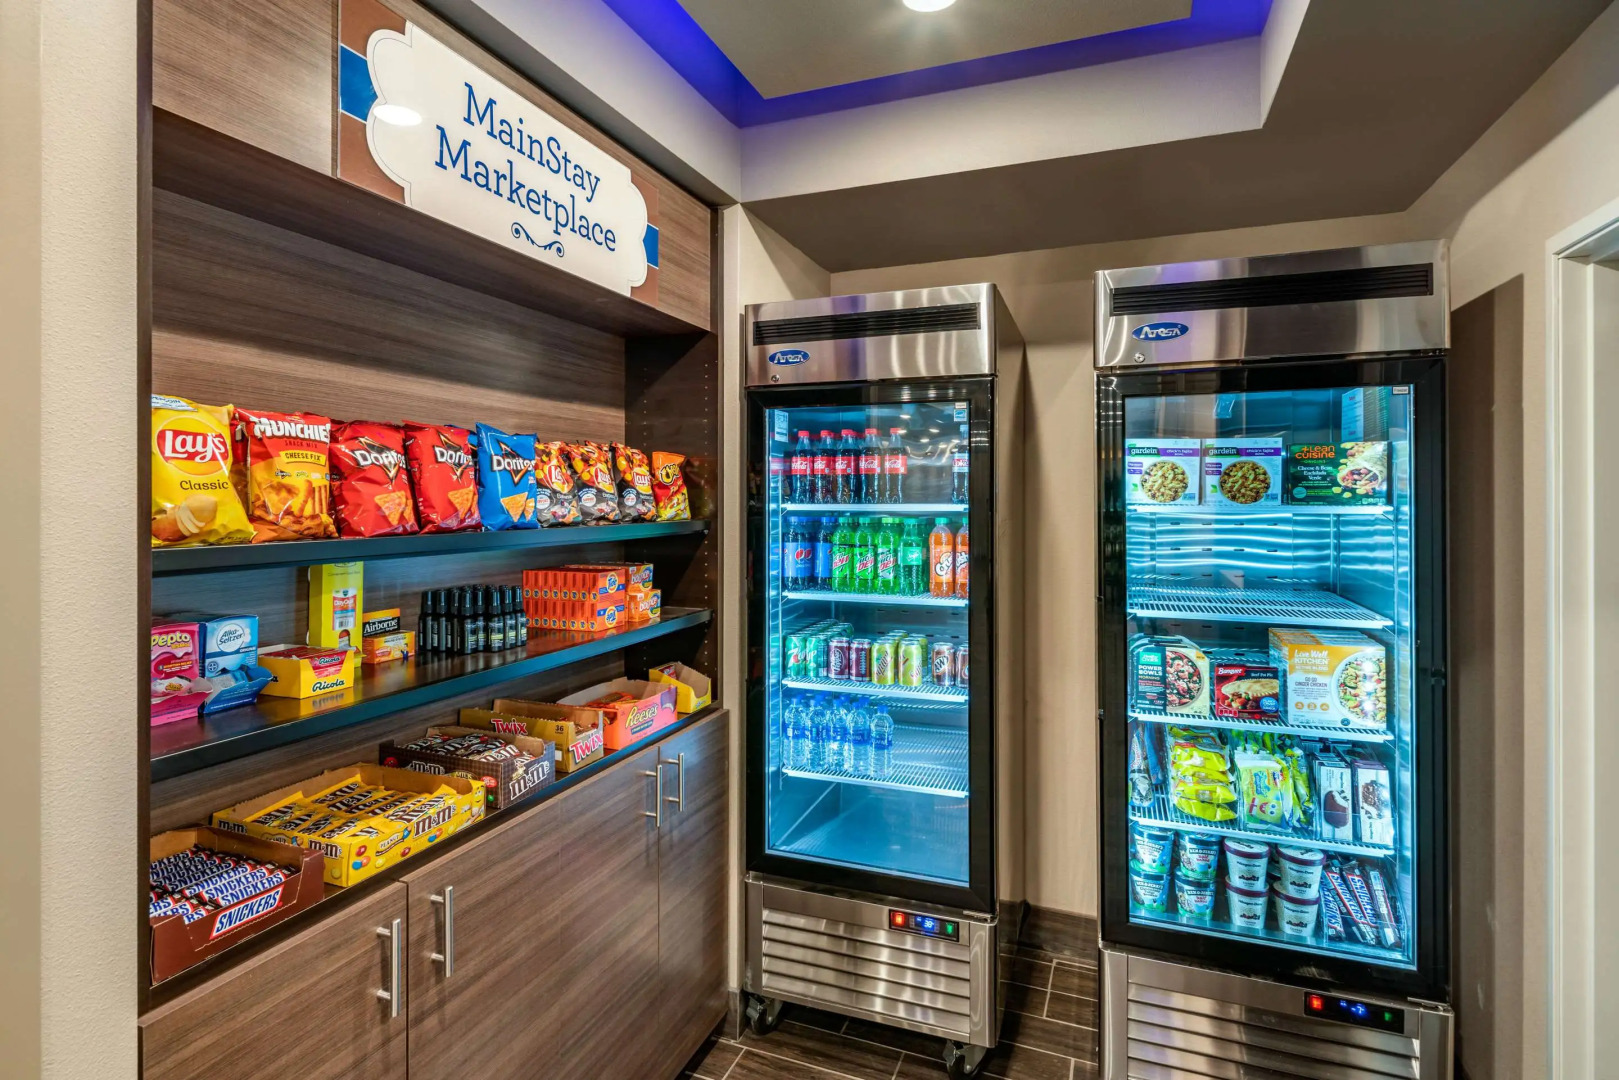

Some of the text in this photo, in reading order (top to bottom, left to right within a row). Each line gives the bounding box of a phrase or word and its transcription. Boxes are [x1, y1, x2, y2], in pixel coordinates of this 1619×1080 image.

[463, 82, 600, 202] MainStay
[434, 125, 616, 251] Marketplace
[164, 430, 226, 463] Lay's
[284, 452, 309, 460] CHEESE
[180, 480, 229, 491] Classic
[219, 632, 243, 645] Seltzer
[222, 629, 239, 637] Alka-
[363, 619, 398, 633] Airborne
[312, 679, 345, 692] Ricola
[625, 703, 659, 729] Reese's
[380, 835, 400, 848] PEANUT
[169, 861, 232, 892] SNICKERS
[185, 863, 249, 897] SNICKERS
[205, 868, 268, 900] SNICKERS
[221, 872, 284, 905] SNICKERS
[215, 889, 280, 934] SNICKERS
